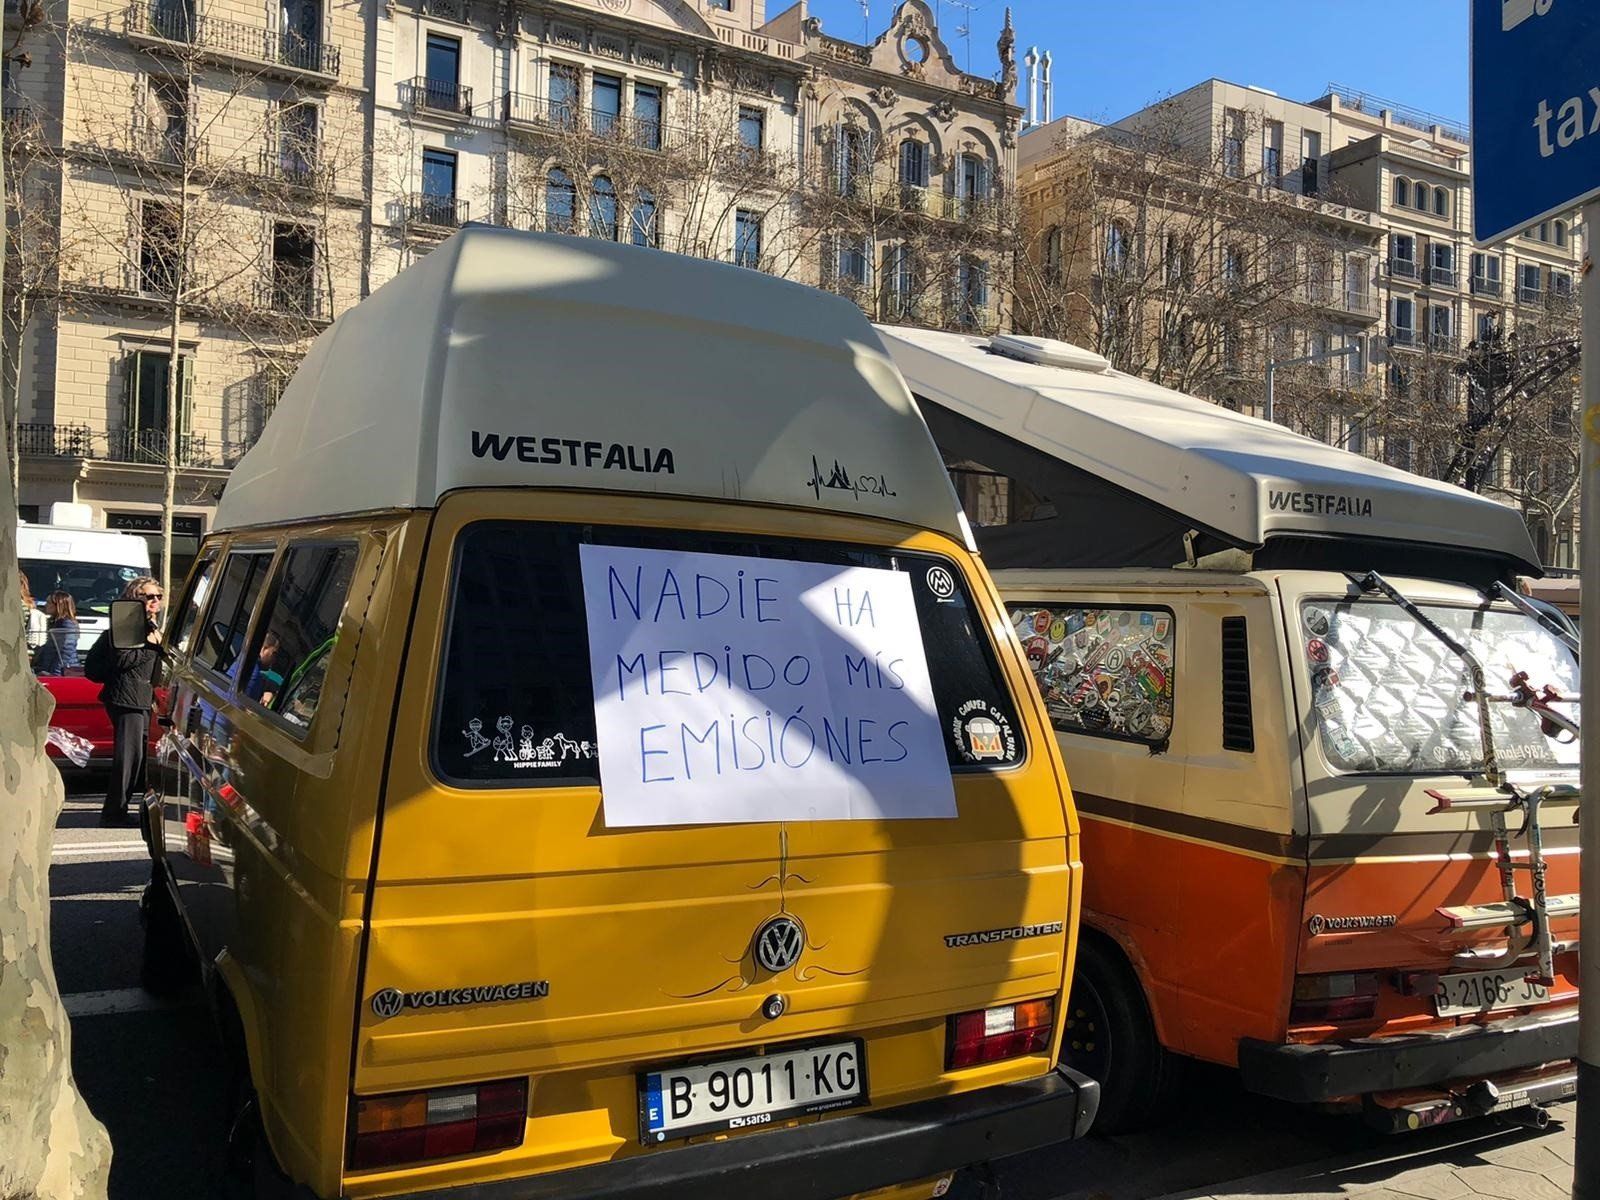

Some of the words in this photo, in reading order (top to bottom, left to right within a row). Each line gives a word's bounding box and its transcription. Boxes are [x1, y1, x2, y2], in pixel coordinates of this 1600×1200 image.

[472, 431, 675, 474] WESTFALIA
[1269, 490, 1372, 517] WESTFALIA
[117, 518, 152, 529] ZARA
[833, 586, 876, 628] HA
[537, 760, 562, 768] FAMILY
[944, 921, 1063, 948] TRANSPORTER
[1326, 914, 1397, 929] VOLKSWAGEN
[408, 981, 549, 1008] VOLKSWAGEN
[746, 1112, 771, 1126] sarsa
